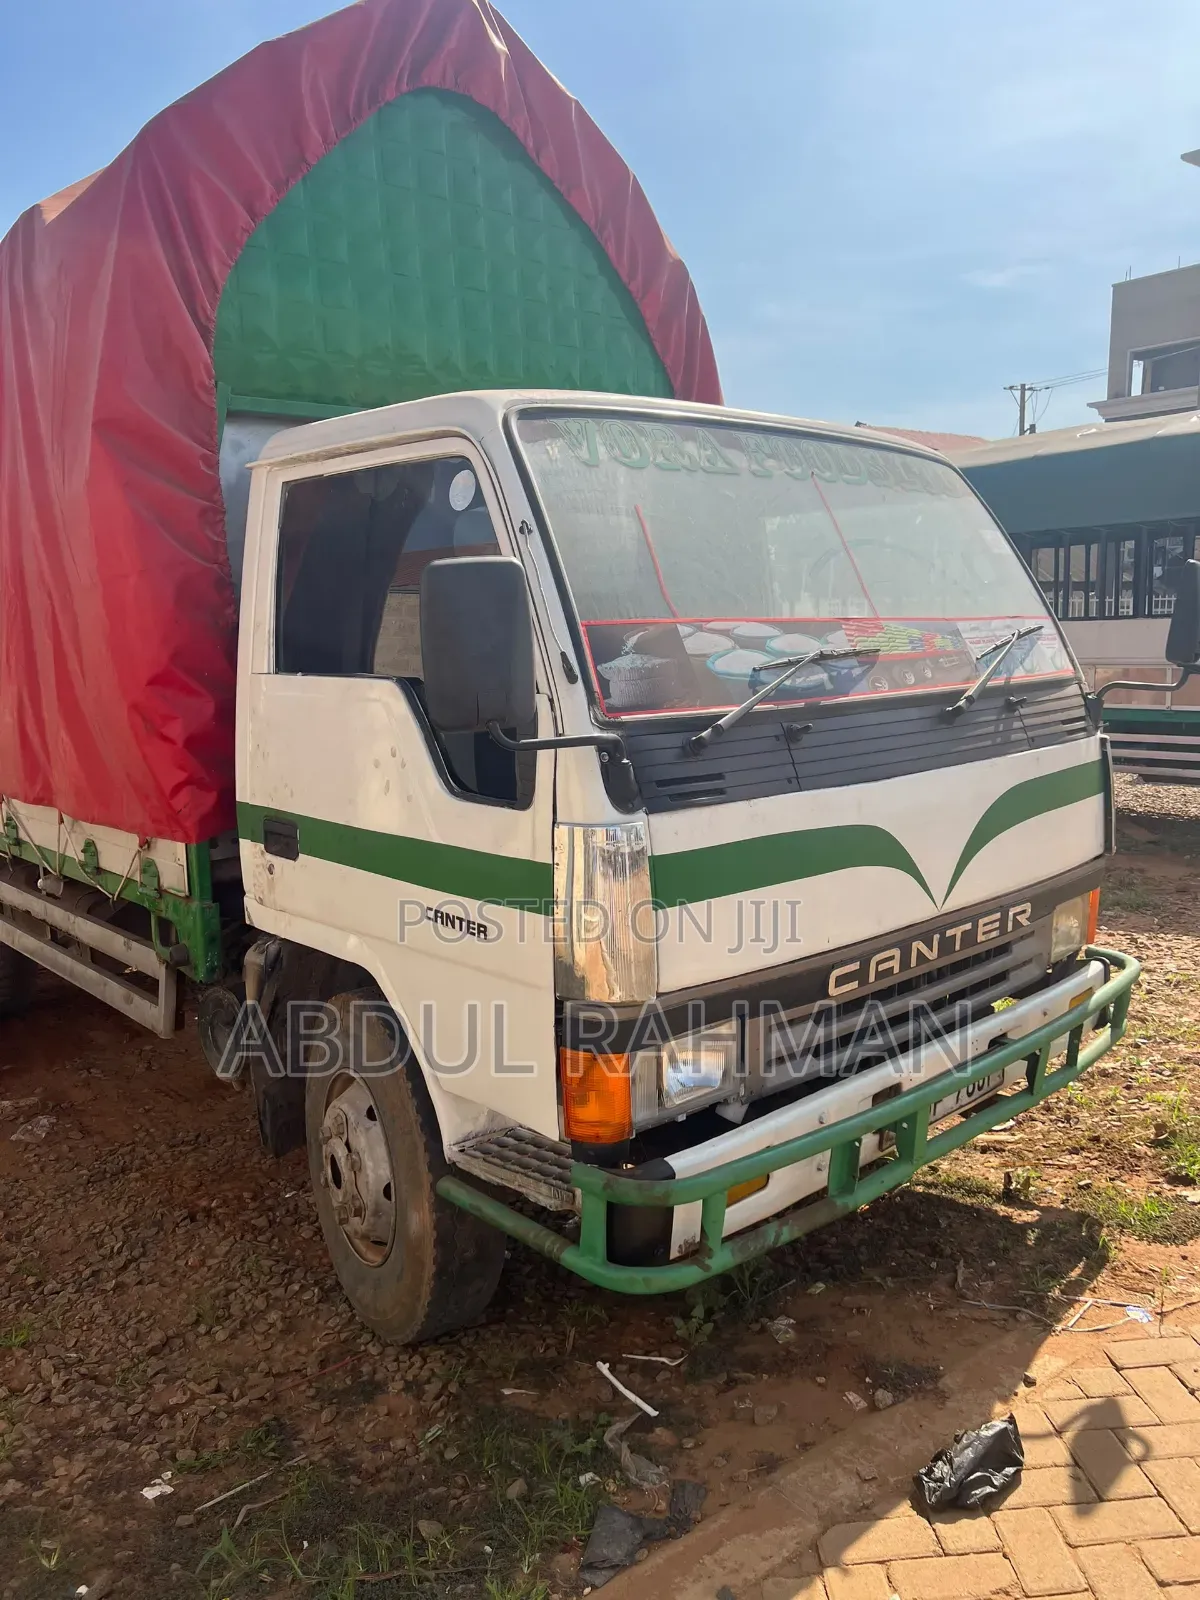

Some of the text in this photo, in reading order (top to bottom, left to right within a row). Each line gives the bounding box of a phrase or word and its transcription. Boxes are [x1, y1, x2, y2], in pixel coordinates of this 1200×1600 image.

[548, 418, 740, 475] VORA
[733, 431, 894, 487] FOODS
[425, 906, 488, 940] CANTER
[827, 902, 1032, 997] CANTER
